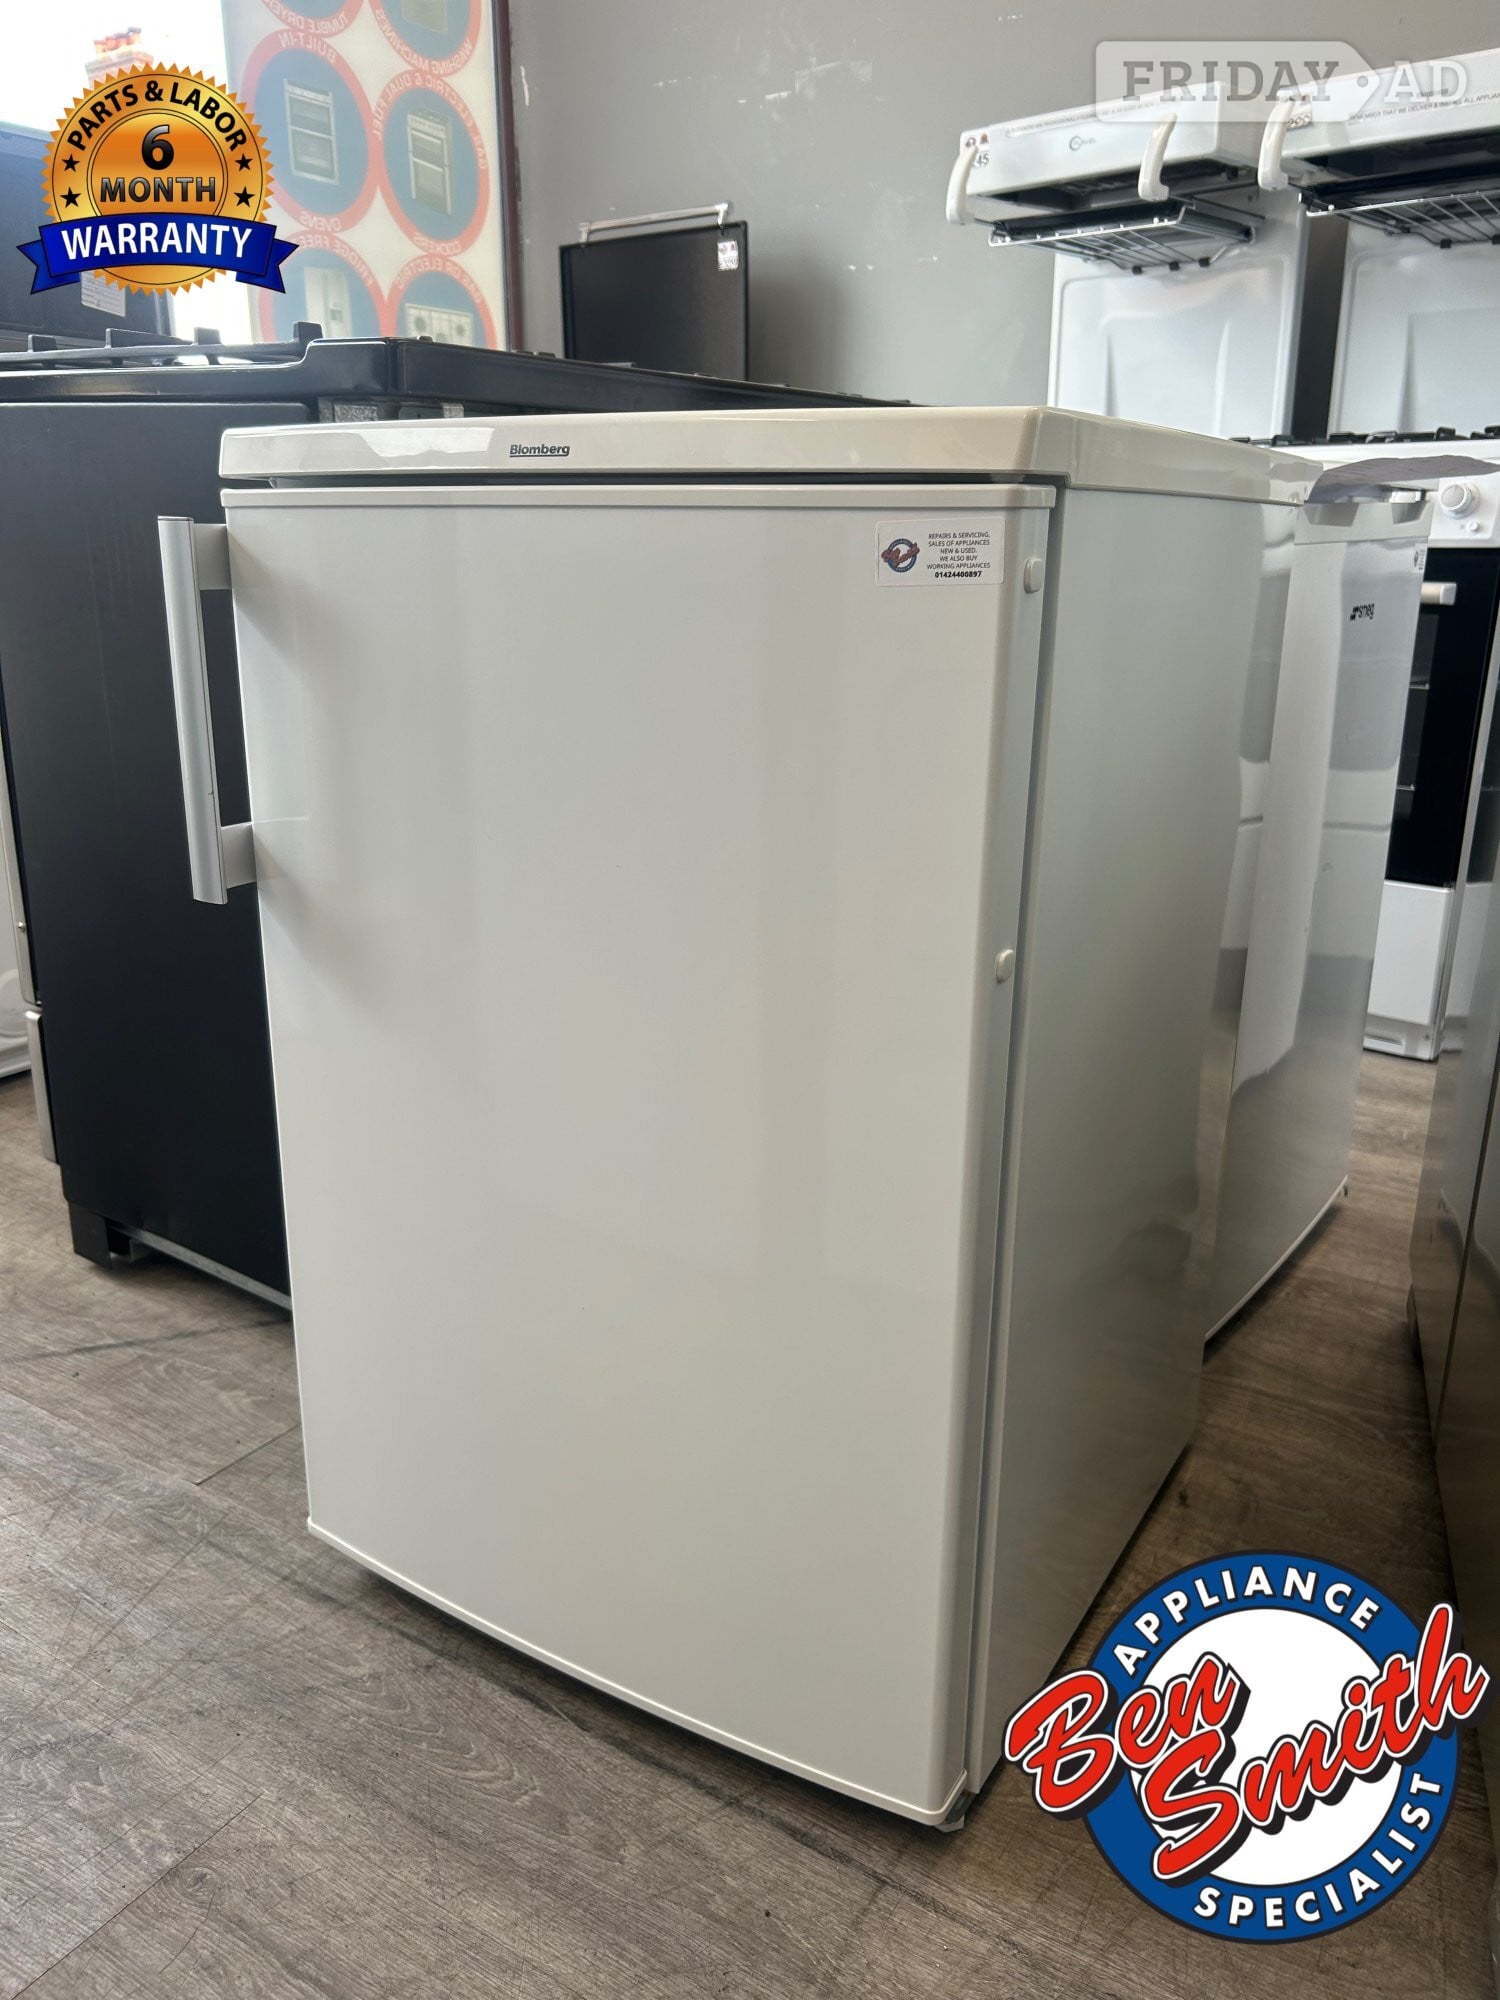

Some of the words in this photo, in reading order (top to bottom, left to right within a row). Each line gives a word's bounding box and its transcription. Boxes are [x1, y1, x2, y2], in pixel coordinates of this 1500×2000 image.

[509, 443, 571, 458] Blomberg
[928, 540, 946, 548] SALES
[955, 539, 990, 547] APPLIANCES
[965, 554, 978, 562] BUY
[927, 562, 955, 570] WORKING
[934, 570, 982, 579] 01424400897
